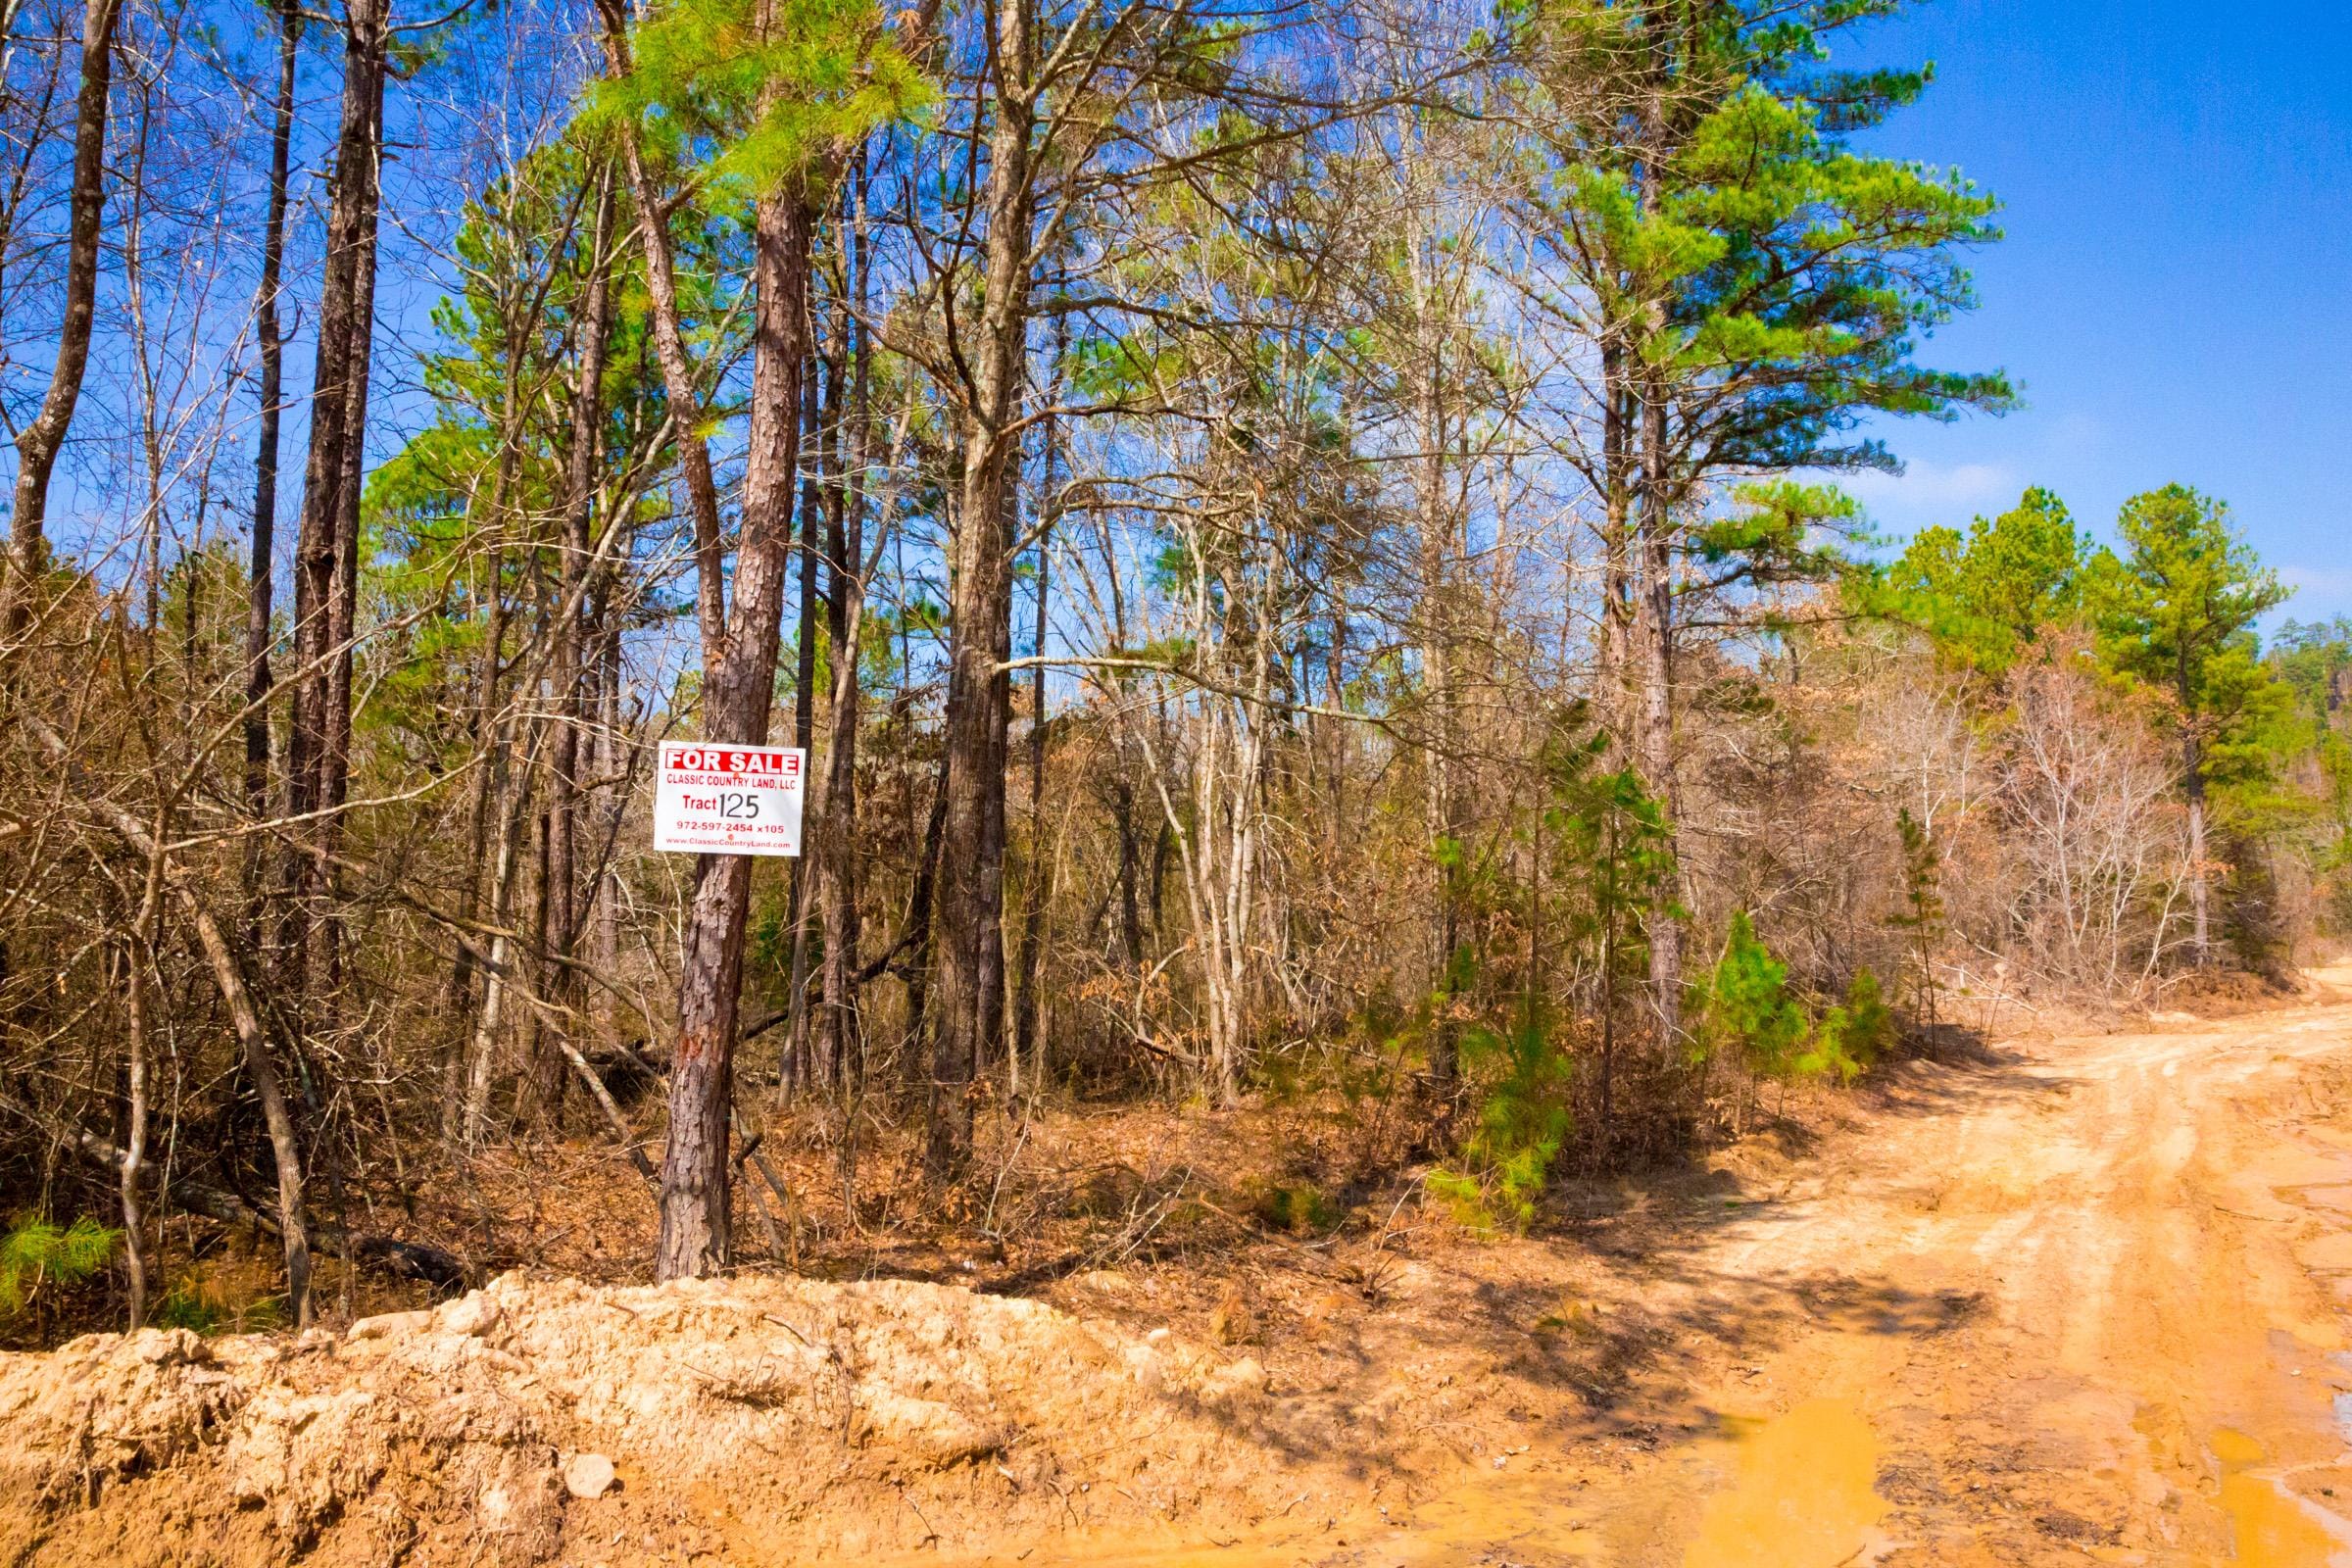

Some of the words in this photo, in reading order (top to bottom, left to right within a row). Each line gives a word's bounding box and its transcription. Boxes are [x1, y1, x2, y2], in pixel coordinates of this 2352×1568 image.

[666, 751, 721, 771] FOR
[729, 753, 798, 775] SALE
[666, 773, 705, 785] CLASSIC
[707, 775, 750, 788] COUNTRY
[752, 778, 777, 791] LAND,
[780, 779, 796, 790] LLC
[682, 795, 717, 810] Tract
[719, 793, 760, 819] 125
[676, 821, 754, 832] 972-597-2454
[757, 825, 784, 834] x105
[665, 837, 791, 849] www.ClassicCountryLand.com
